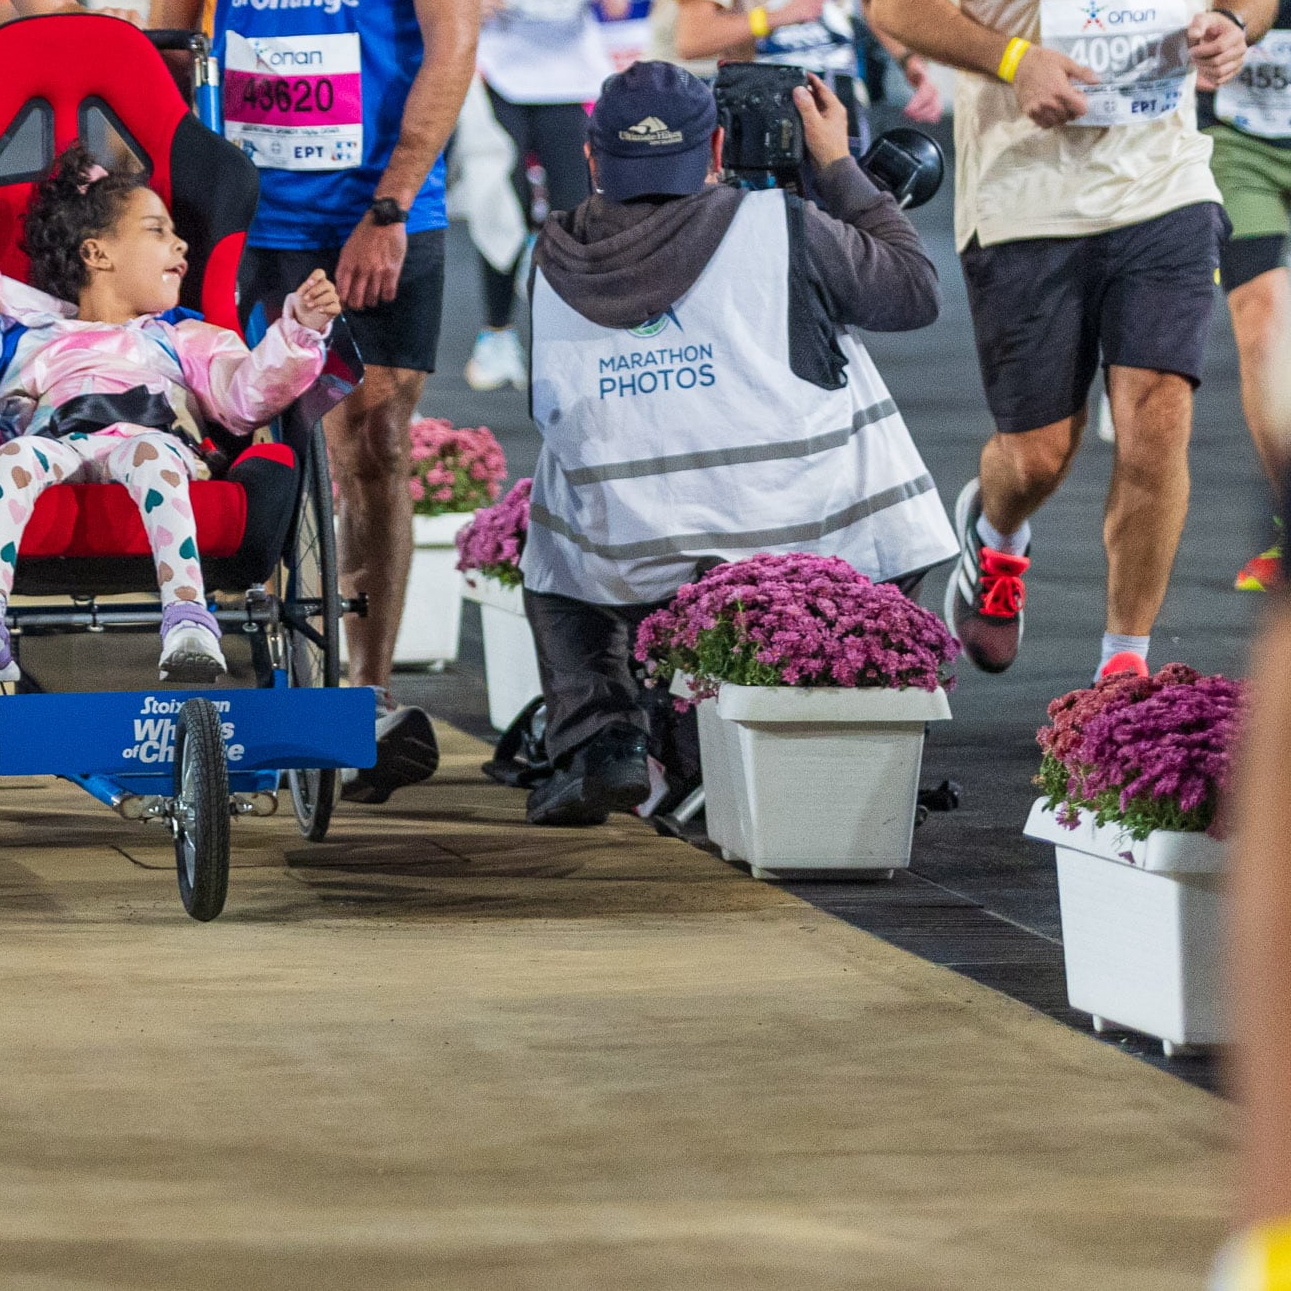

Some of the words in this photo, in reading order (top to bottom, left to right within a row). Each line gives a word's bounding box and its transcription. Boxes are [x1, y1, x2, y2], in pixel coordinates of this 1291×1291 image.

[243, 77, 334, 112] 43620
[599, 343, 714, 374] MARATHON
[599, 363, 716, 400] PHOTOS
[122, 744, 140, 759] of
